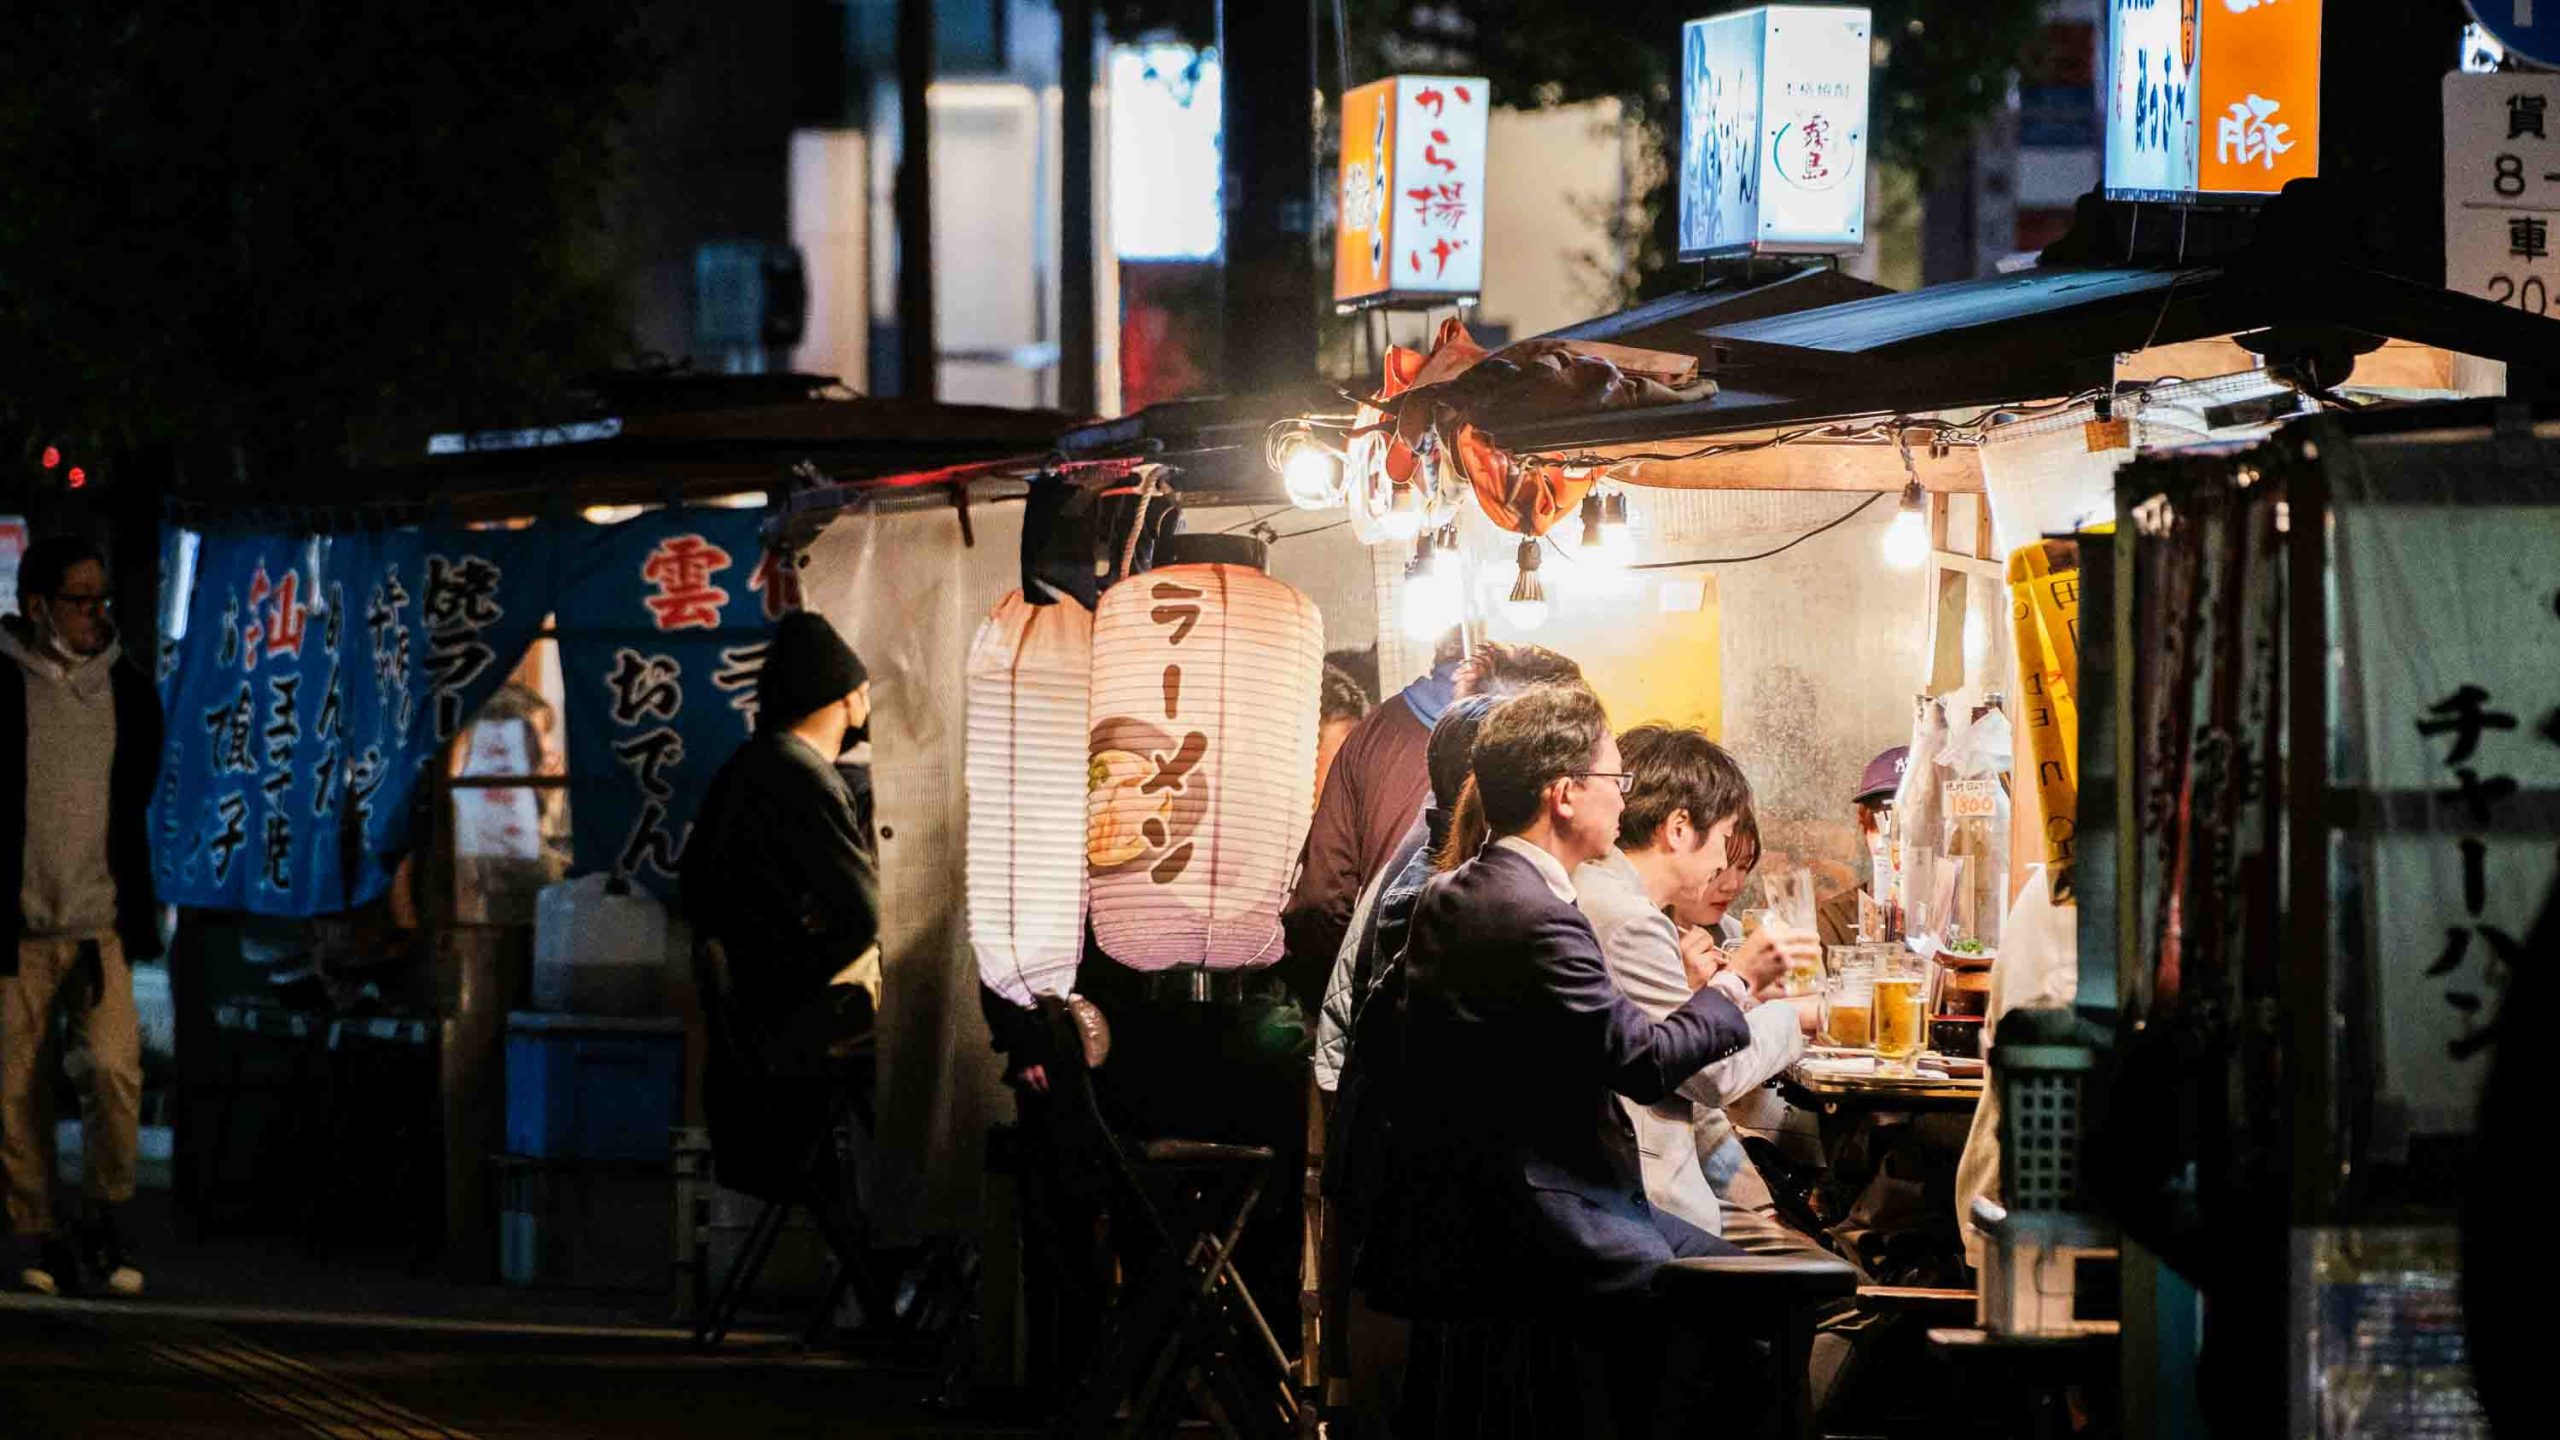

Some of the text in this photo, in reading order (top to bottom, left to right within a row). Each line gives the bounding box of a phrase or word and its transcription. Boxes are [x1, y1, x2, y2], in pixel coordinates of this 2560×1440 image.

[2506, 94, 2547, 140] 貨
[1406, 85, 1471, 281] から揚げ
[2508, 216, 2549, 263] 車
[2488, 275, 2560, 317] 20
[606, 648, 697, 876] おでん
[1141, 581, 1209, 886] ラーメン
